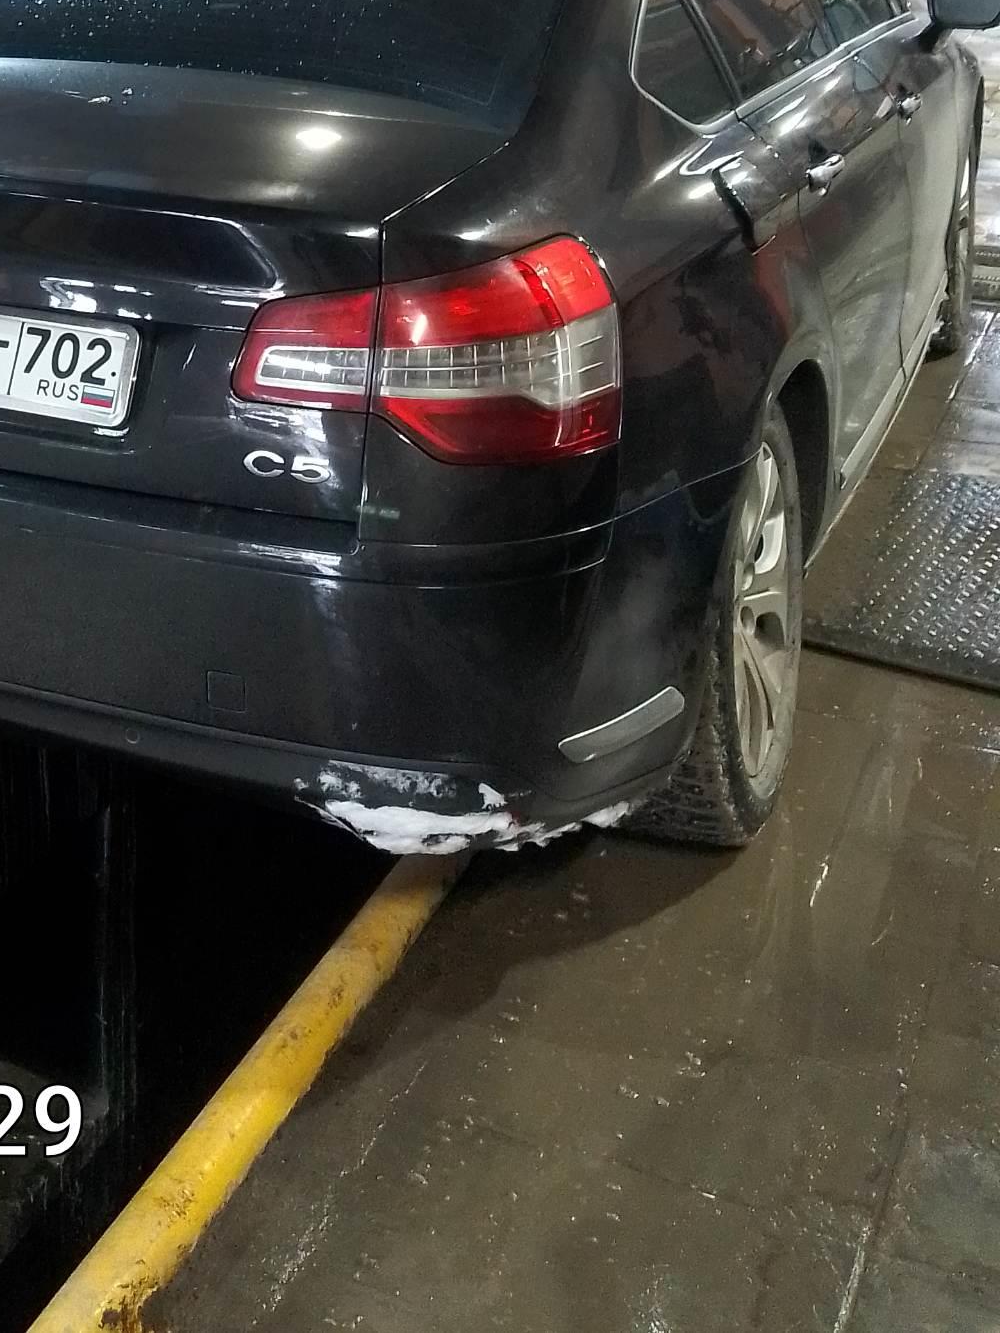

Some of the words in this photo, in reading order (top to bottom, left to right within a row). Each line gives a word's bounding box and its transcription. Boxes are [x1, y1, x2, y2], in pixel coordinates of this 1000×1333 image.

[24, 327, 112, 386] 702
[36, 379, 80, 401] RUS
[243, 450, 332, 484] C5
